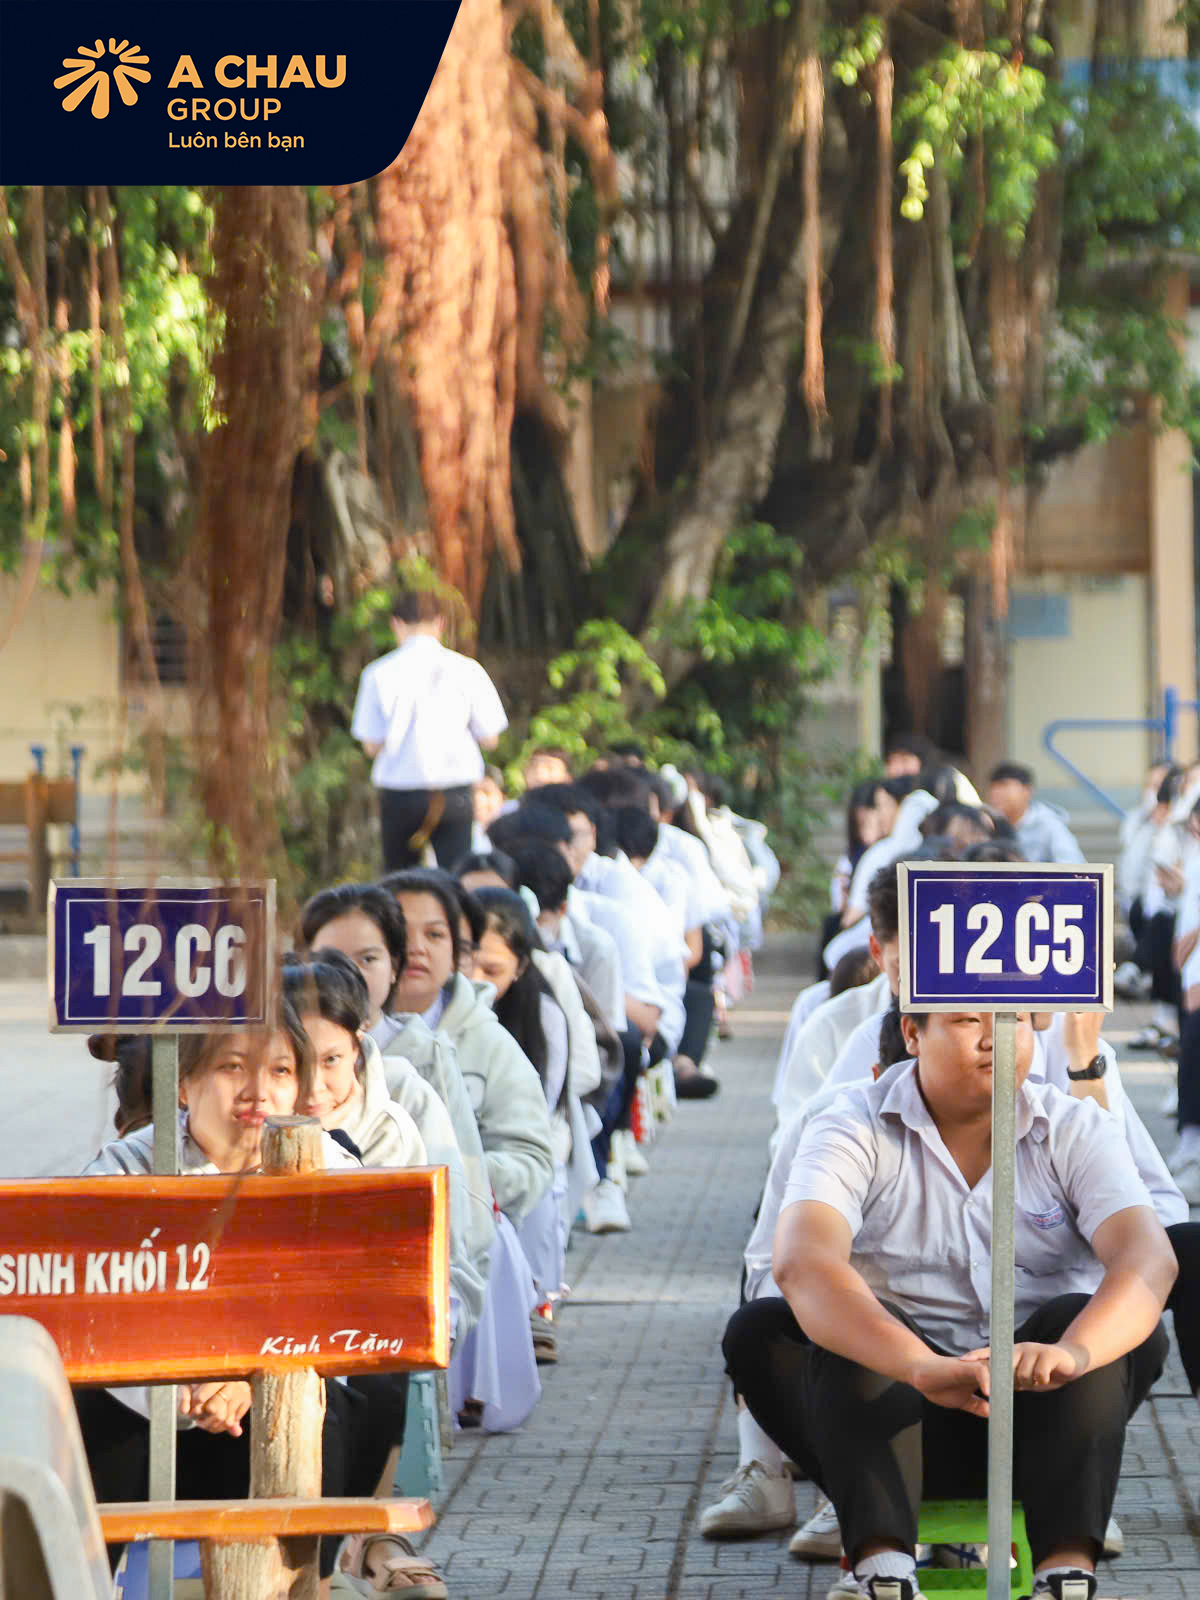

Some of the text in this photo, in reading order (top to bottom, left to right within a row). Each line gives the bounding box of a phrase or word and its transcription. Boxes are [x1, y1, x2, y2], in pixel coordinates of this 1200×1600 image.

[0, 1227, 211, 1296] SINH KHỐI 12
